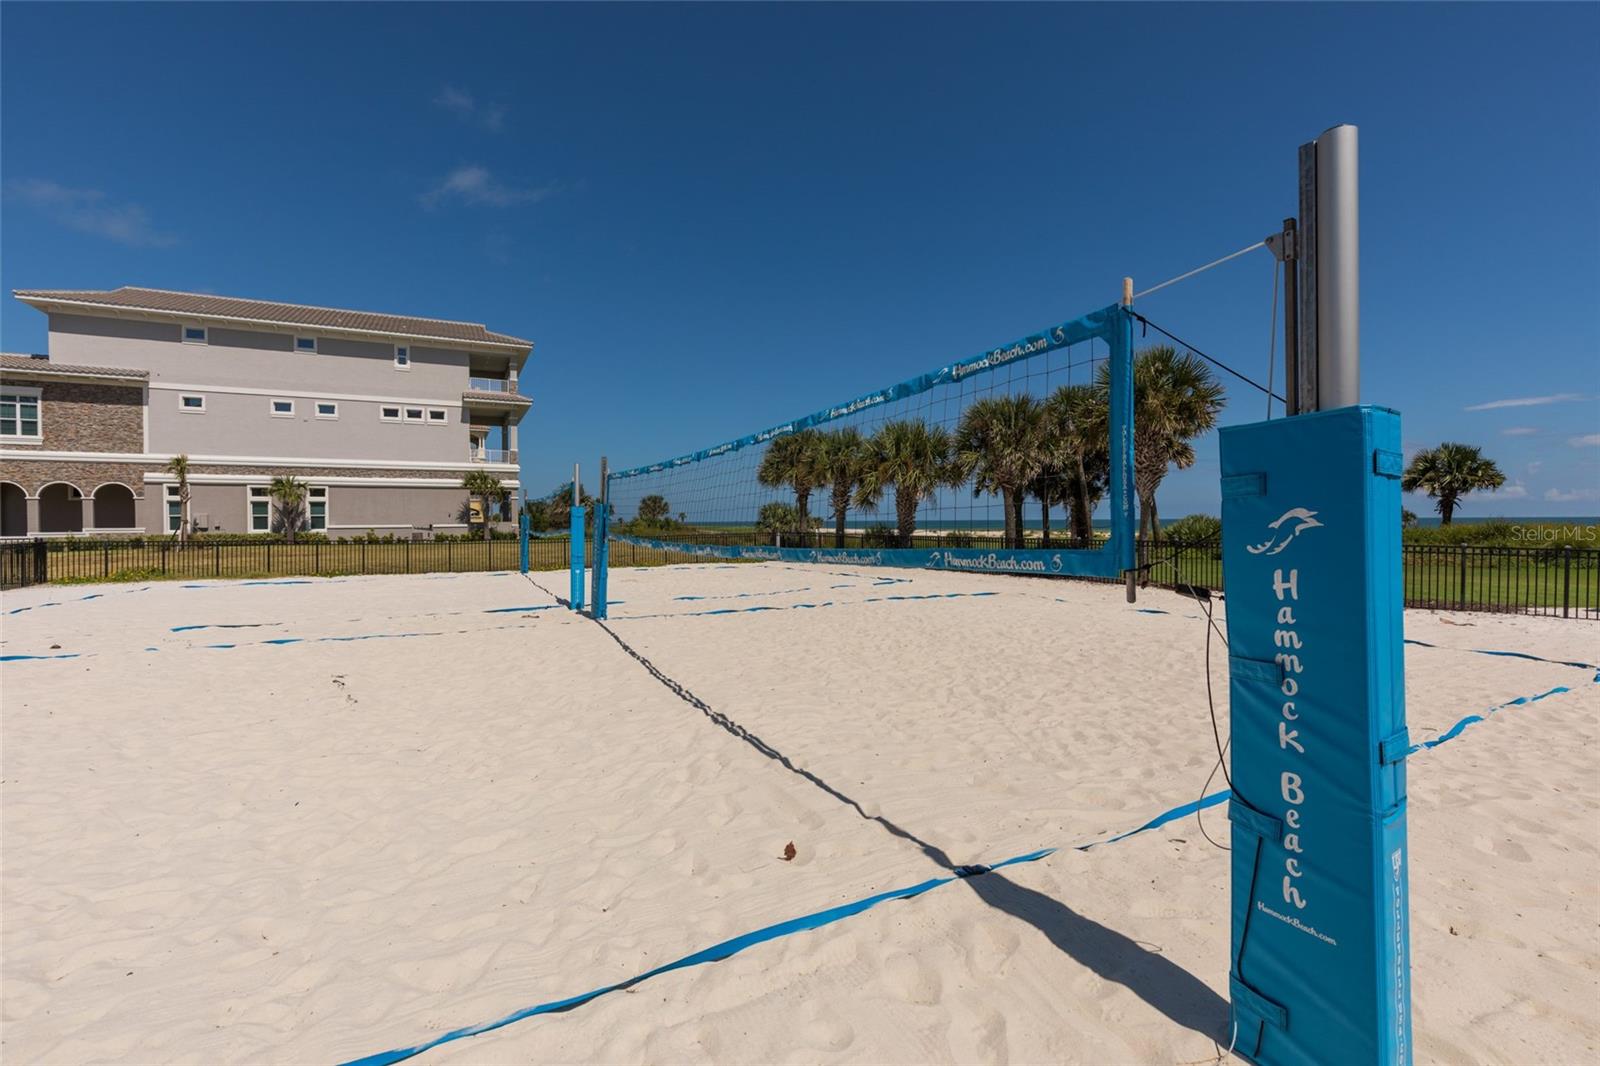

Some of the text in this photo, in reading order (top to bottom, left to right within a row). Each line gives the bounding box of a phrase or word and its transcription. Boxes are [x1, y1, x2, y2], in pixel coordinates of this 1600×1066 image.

[943, 550, 1045, 571] HammockBeach.com
[1272, 569, 1307, 909] Hammock Beach
[1257, 901, 1337, 946] HammockBeach.com
